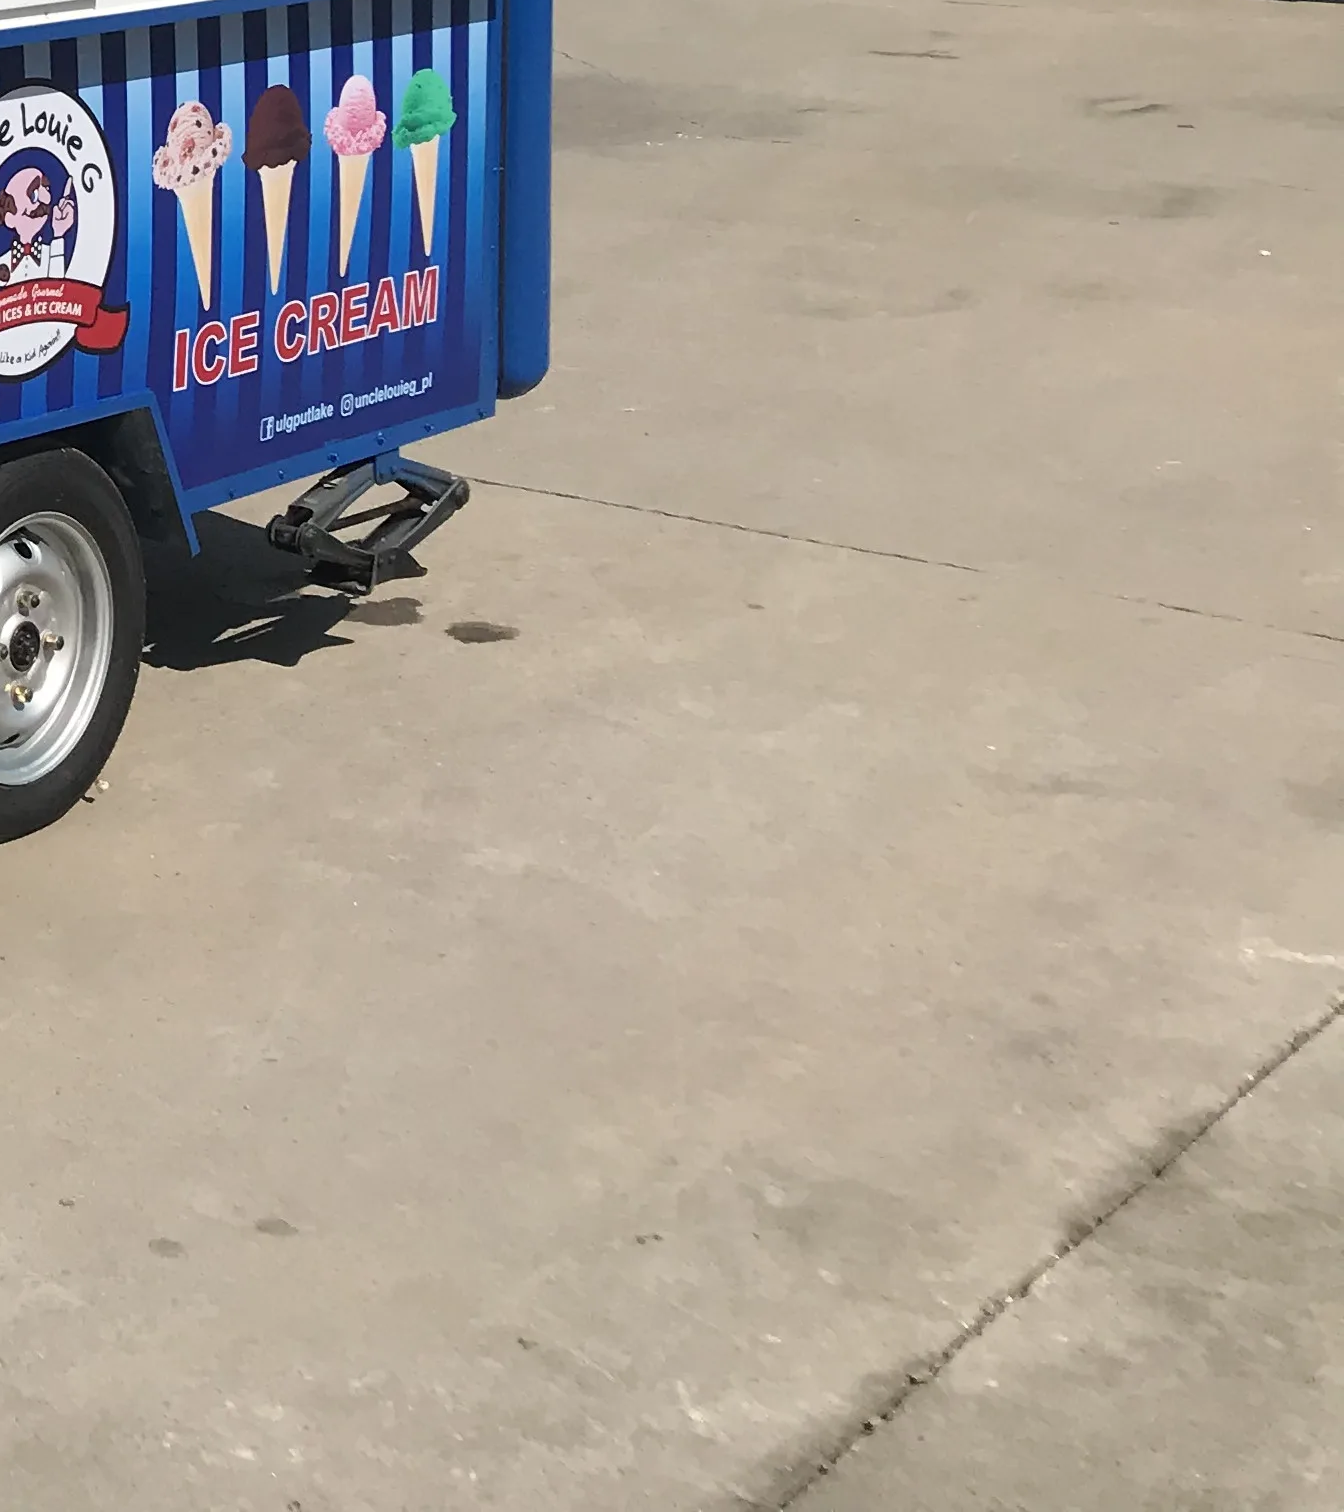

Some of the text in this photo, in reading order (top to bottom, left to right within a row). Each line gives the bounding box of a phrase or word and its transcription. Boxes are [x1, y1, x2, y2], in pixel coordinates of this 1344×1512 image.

[20, 102, 83, 162] Louie
[81, 162, 104, 194] G
[2, 305, 23, 323] ICES
[24, 304, 32, 316] &
[33, 302, 48, 316] ICE
[48, 301, 82, 317] CREAM
[172, 265, 440, 392] ICE CREAM
